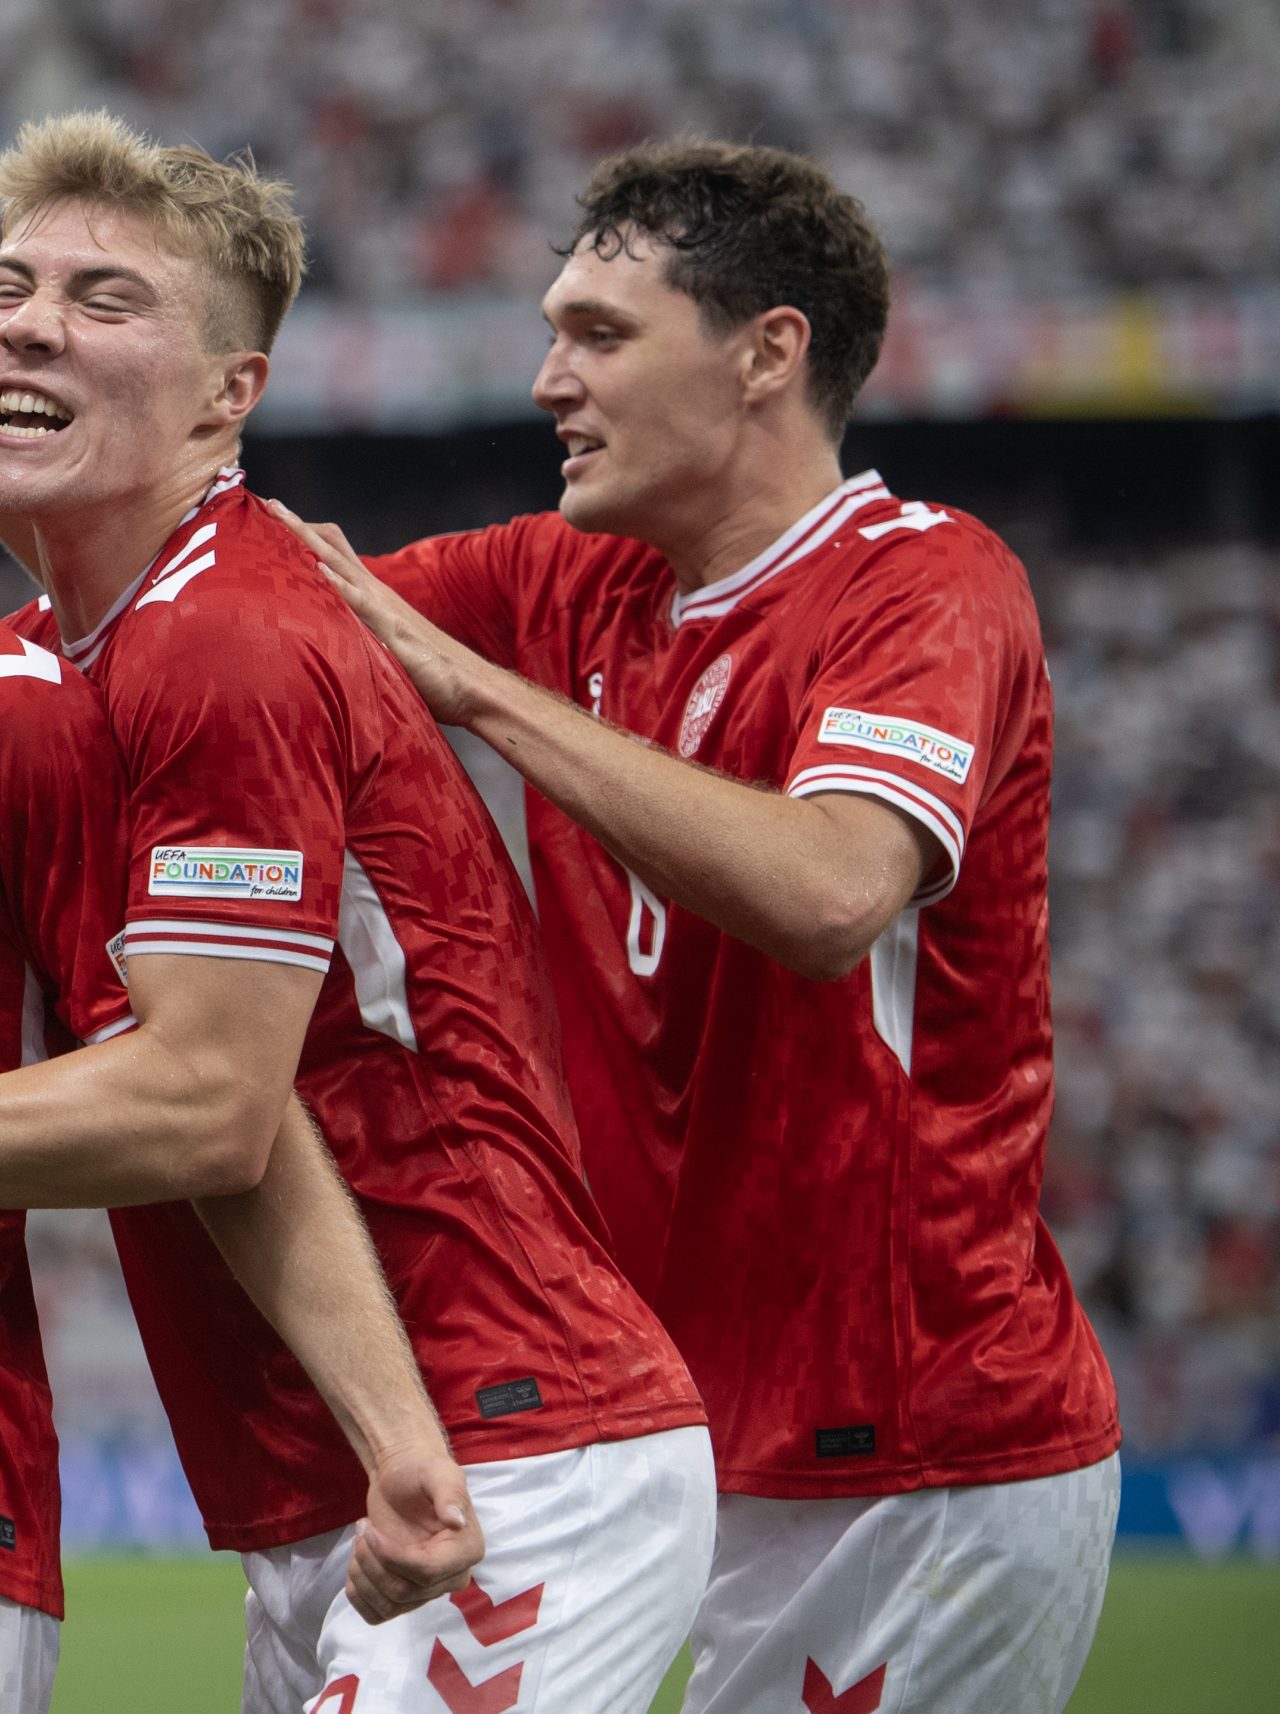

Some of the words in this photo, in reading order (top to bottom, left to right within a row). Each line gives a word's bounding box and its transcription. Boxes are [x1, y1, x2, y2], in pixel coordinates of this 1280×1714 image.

[828, 710, 861, 721] UEFA
[825, 719, 967, 769] FOUNDATION
[155, 850, 187, 861] UEFA
[153, 862, 299, 883] FOUNDATION
[250, 886, 264, 897] for
[265, 886, 298, 897] children
